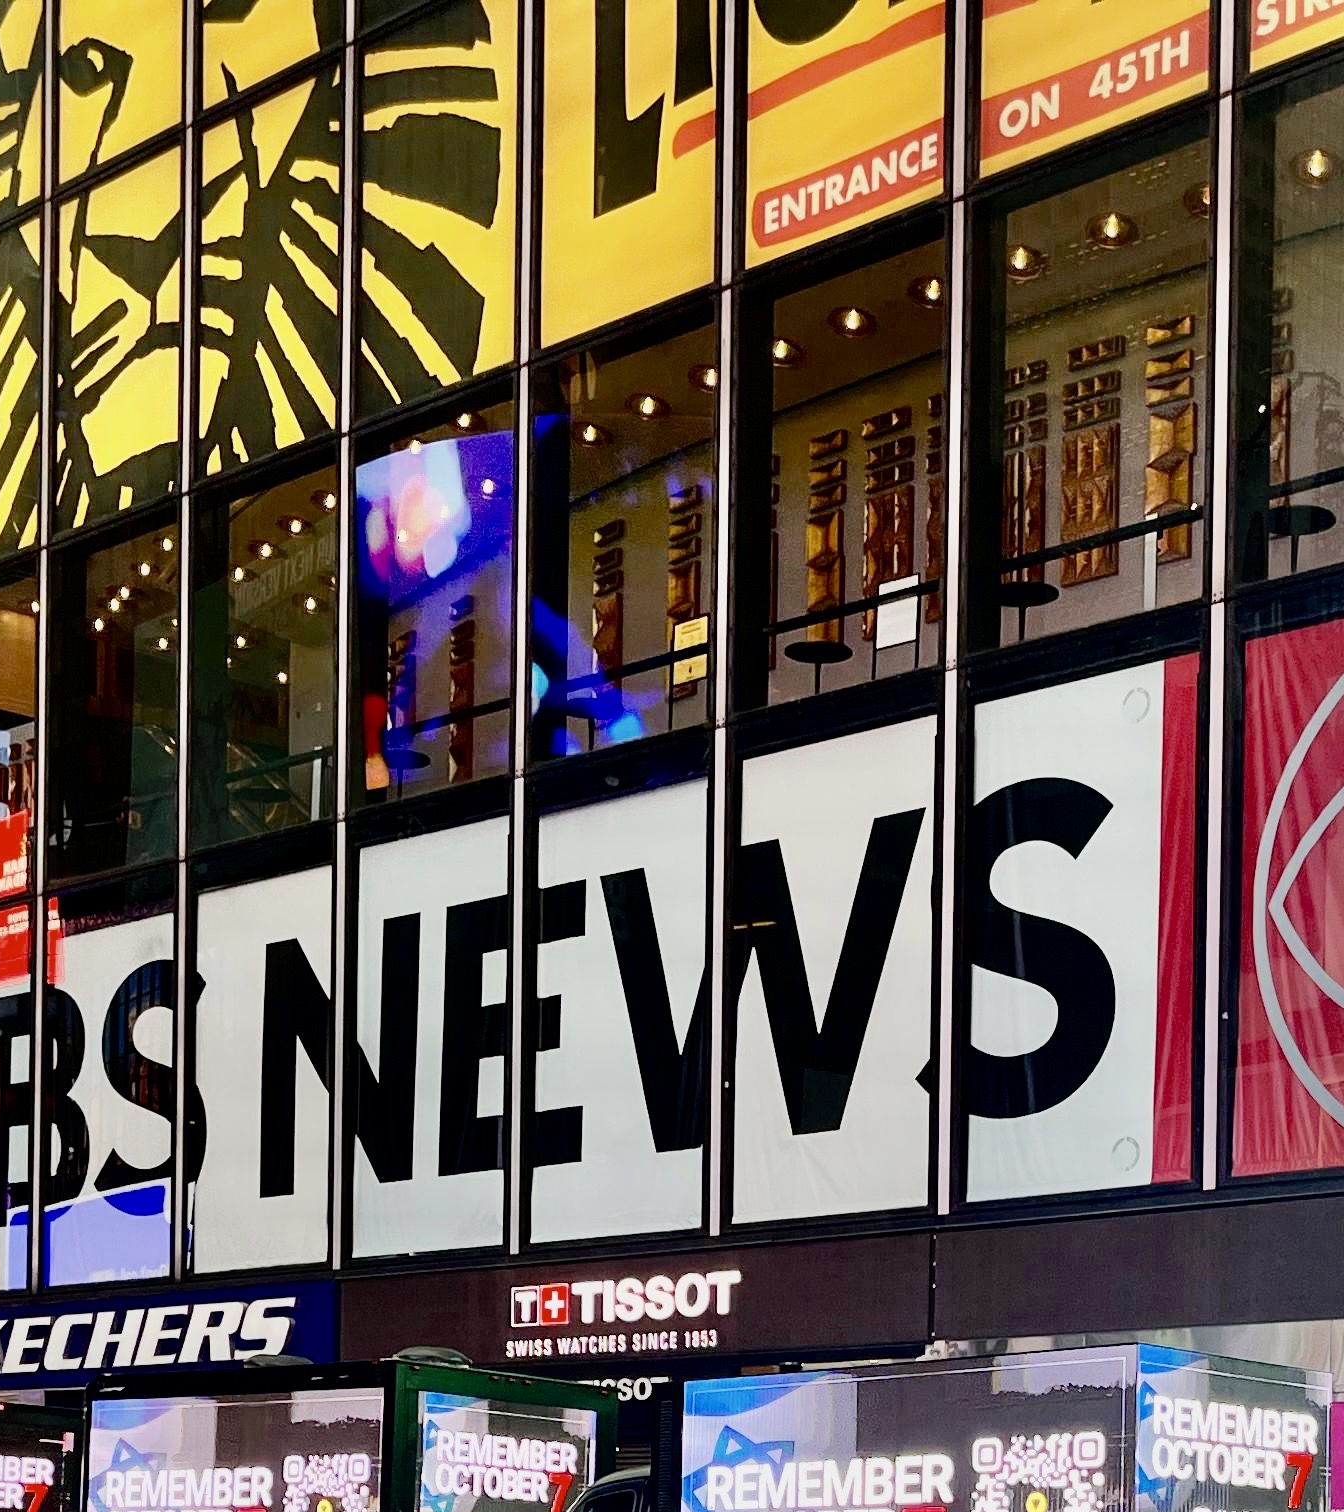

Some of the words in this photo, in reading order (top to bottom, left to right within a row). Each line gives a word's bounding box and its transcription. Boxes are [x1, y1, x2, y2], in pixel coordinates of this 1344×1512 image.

[762, 132, 939, 237] ENTRANCE
[998, 84, 1061, 139] ON
[1088, 30, 1190, 101] 45TH
[260, 777, 1116, 1197] NEWS
[571, 1270, 742, 1324] TISSOT
[506, 1338, 552, 1358] SWISS
[557, 1334, 627, 1355] WATCHES
[632, 1331, 678, 1352] SINCE
[684, 1328, 718, 1348] 1853
[435, 1429, 578, 1474] REMEMBER
[1151, 1393, 1320, 1455] REMEMBER
[105, 1466, 273, 1508] REMEMBER
[433, 1463, 549, 1503] OCTOBER
[704, 1453, 955, 1511] REMEMBER
[1151, 1438, 1287, 1492] OCTOBER
[1284, 1452, 1314, 1511] 7
